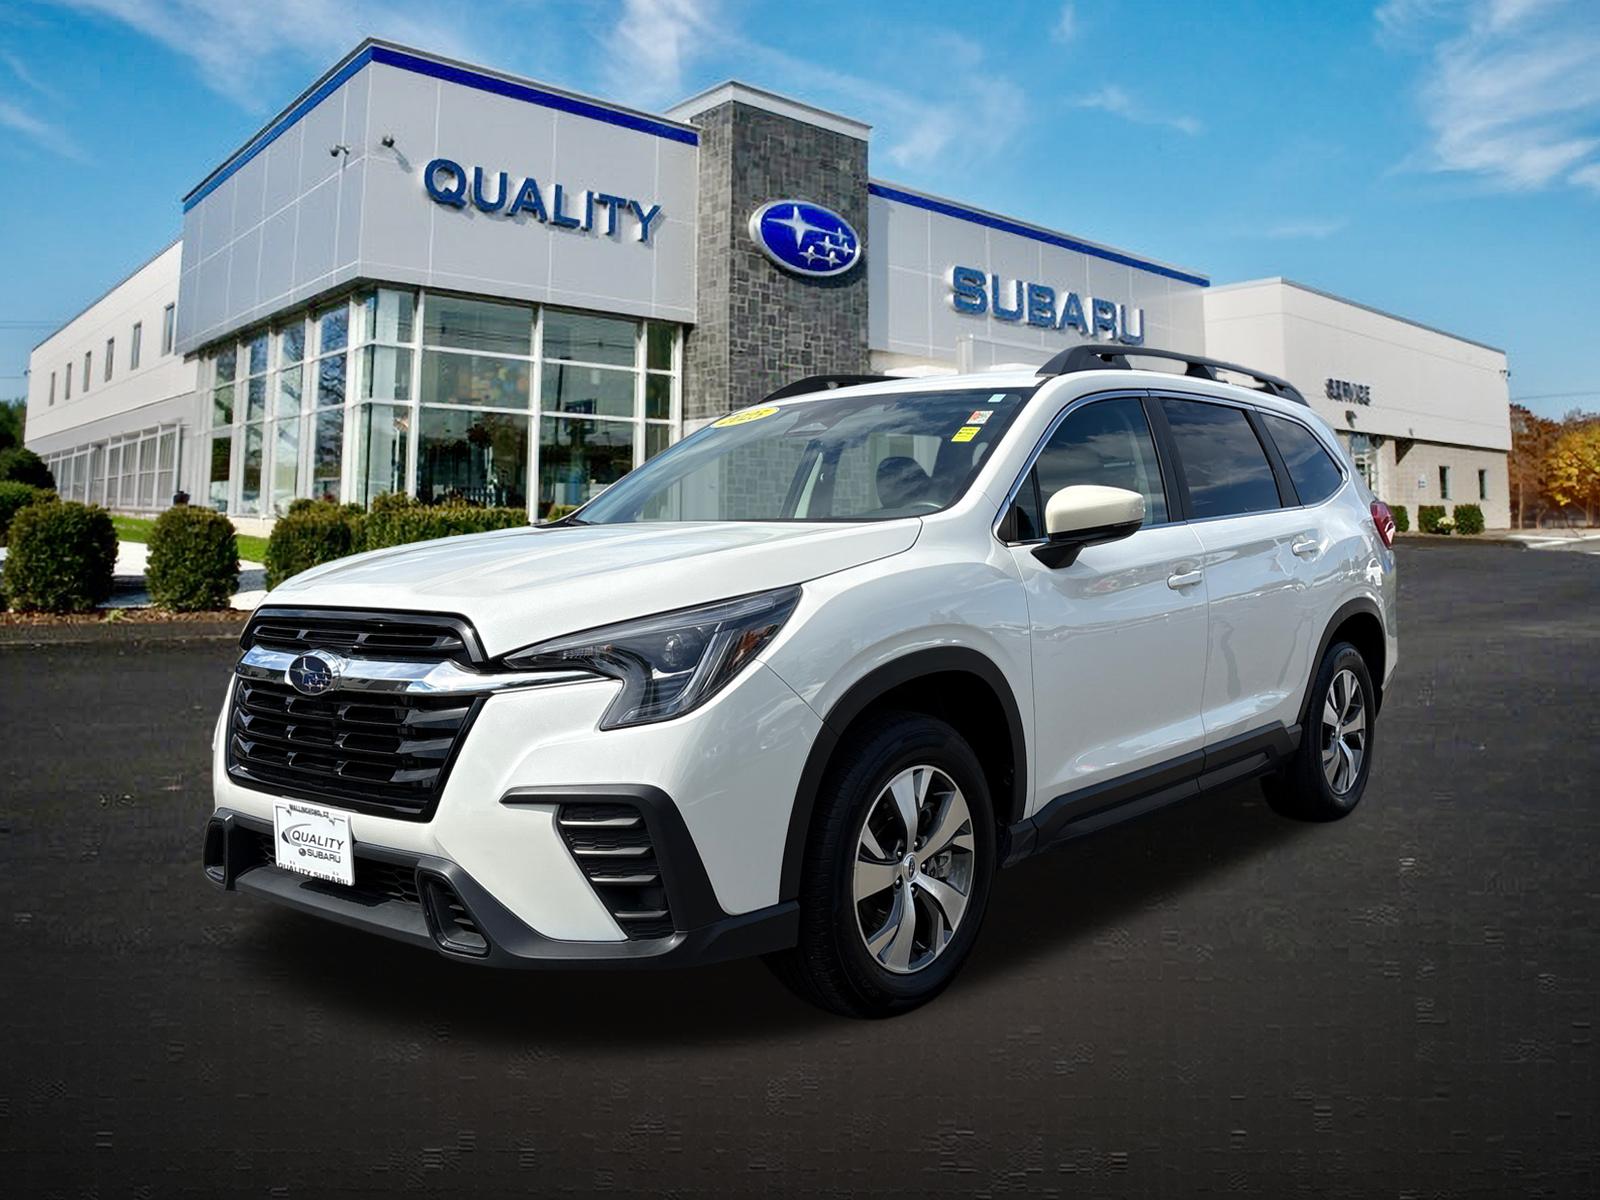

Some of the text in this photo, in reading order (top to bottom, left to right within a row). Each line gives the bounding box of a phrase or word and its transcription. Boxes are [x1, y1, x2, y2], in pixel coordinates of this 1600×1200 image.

[423, 158, 662, 243] QUALITY
[949, 265, 1145, 346] SUBARU
[1324, 378, 1371, 406] SERVICE
[291, 830, 344, 850] QUALITY
[306, 848, 341, 864] SUBARU
